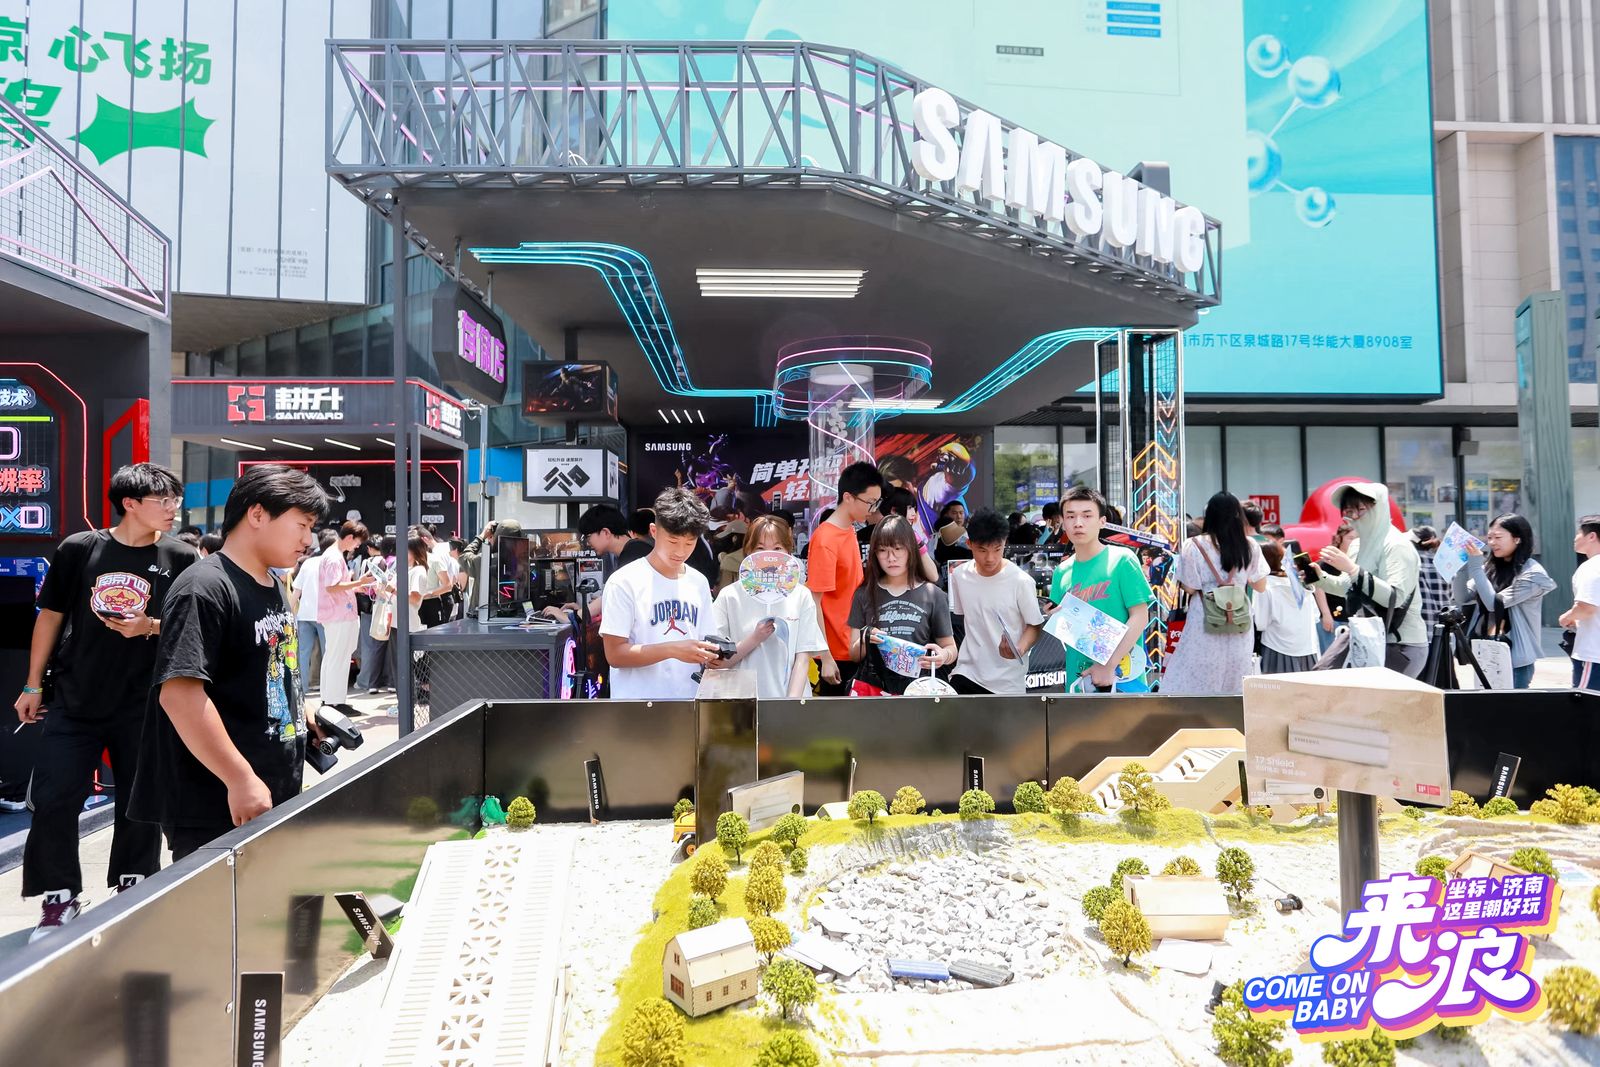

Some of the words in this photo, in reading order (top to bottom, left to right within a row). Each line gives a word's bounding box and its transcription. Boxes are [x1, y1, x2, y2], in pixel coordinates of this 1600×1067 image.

[912, 87, 1205, 273] SAMSUNG
[275, 387, 344, 411] 耕升
[275, 412, 344, 420] GAINWARD
[644, 442, 692, 452] SAMSUNG
[650, 600, 699, 627] JORDAN
[879, 610, 922, 623] alifornia
[591, 772, 599, 810] SAMSUNG
[352, 907, 382, 946] SAMSUNG
